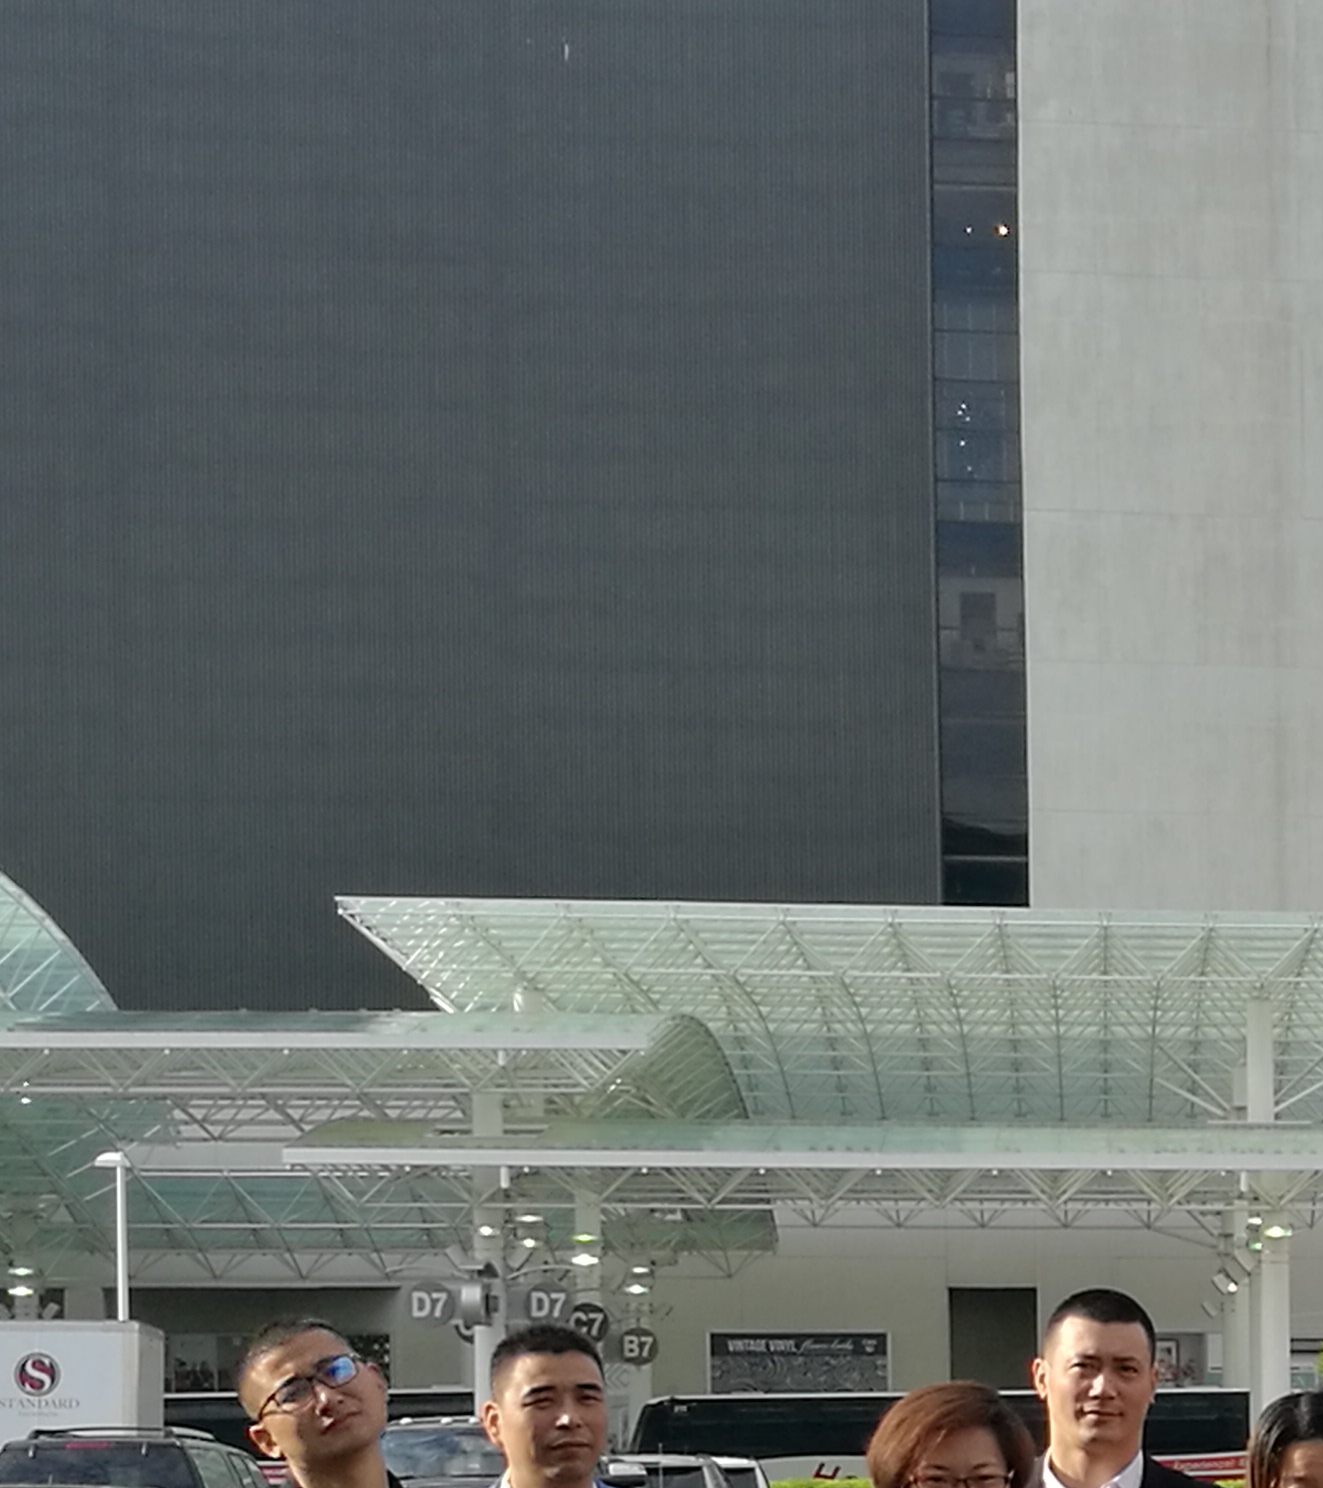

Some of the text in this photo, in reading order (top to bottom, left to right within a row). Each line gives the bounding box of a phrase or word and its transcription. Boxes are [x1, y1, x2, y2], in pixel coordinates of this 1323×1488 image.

[411, 1291, 447, 1318] D7
[530, 1291, 566, 1318] D7
[623, 1335, 653, 1357] B7
[727, 1339, 767, 1352] VINTAGE
